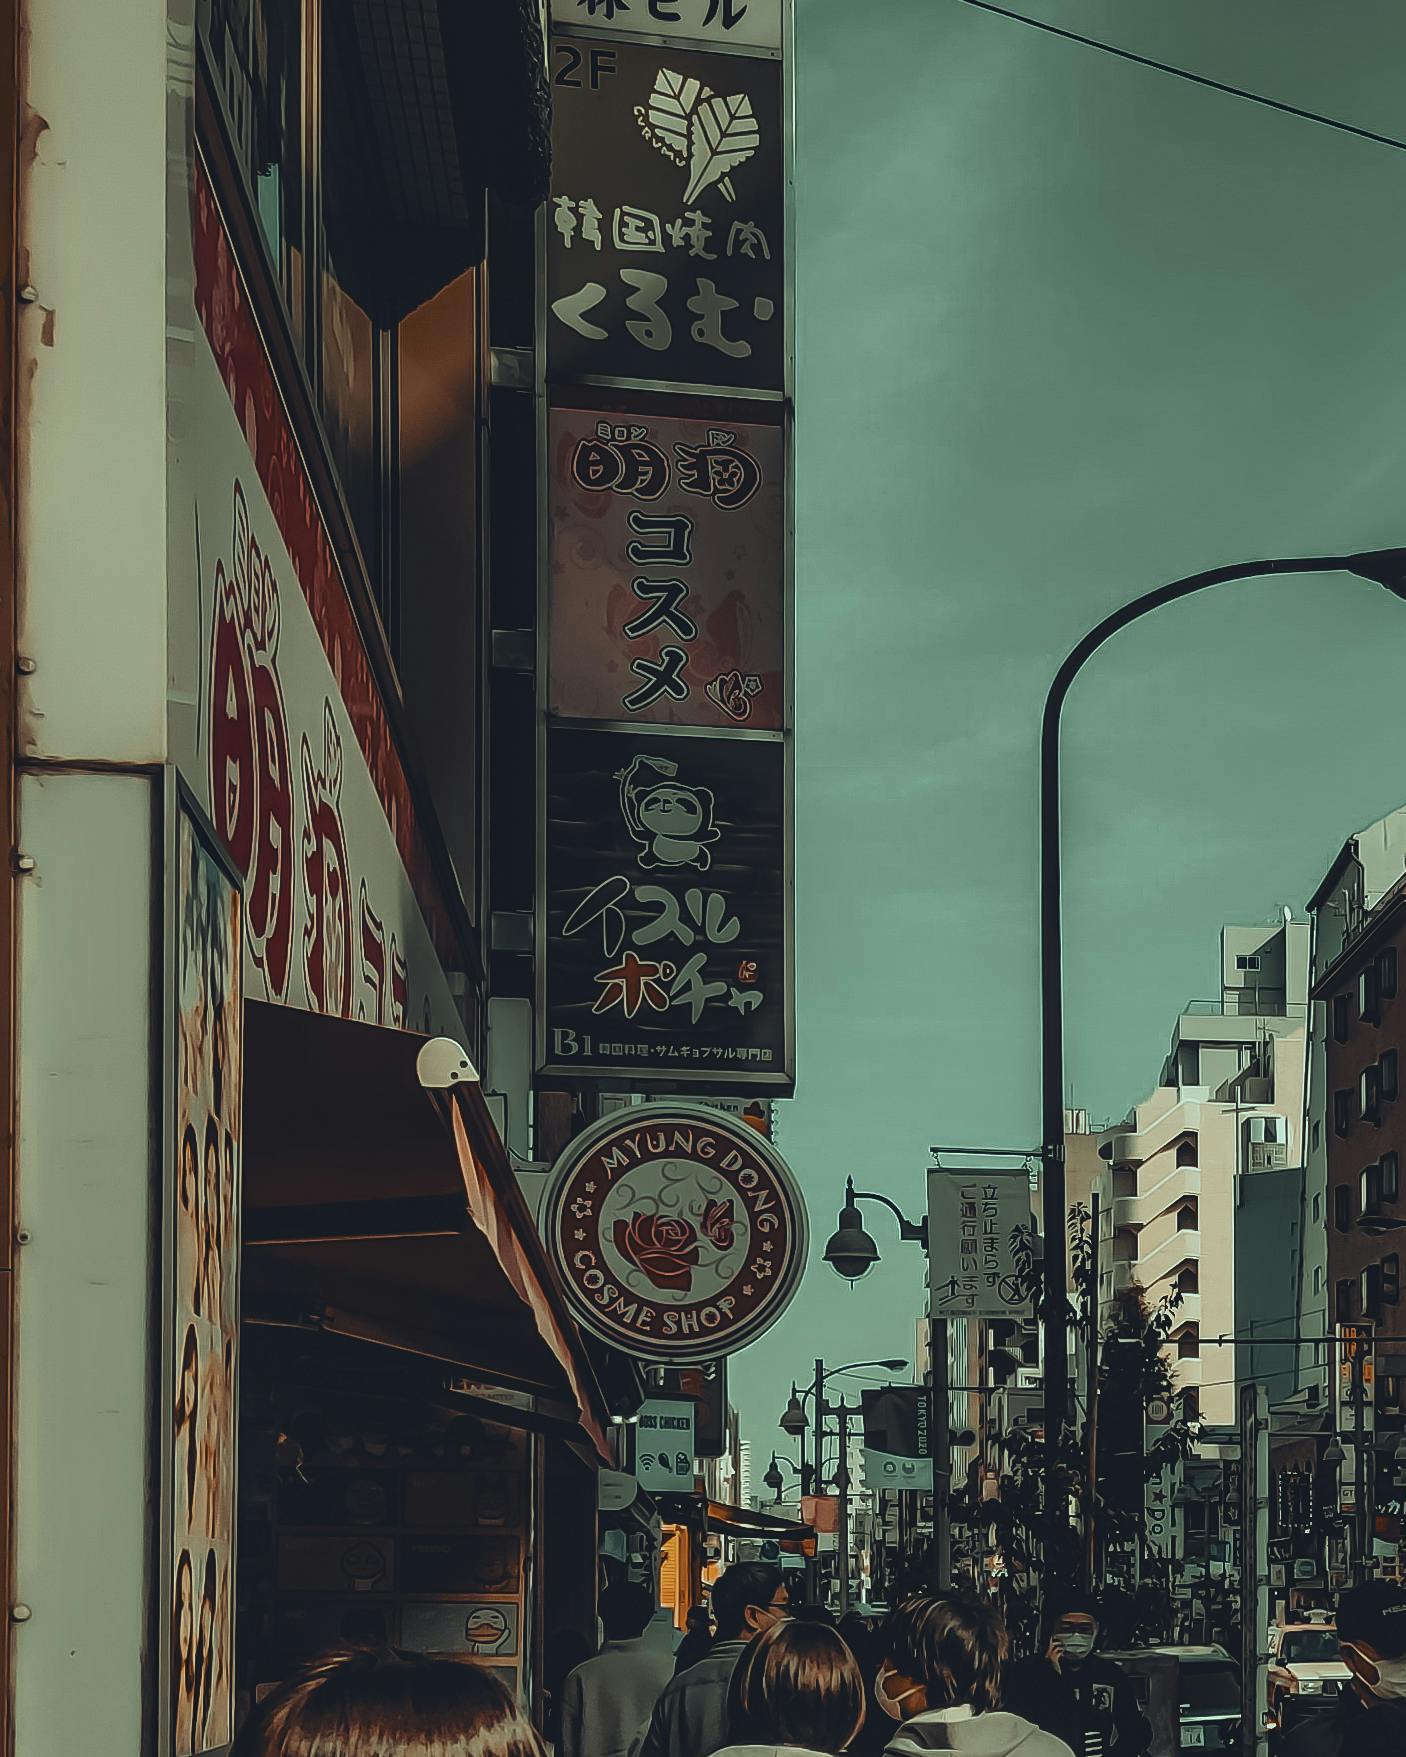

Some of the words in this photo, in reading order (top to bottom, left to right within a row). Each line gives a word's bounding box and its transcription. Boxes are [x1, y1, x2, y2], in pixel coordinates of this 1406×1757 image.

[554, 46, 617, 89] 2F
[552, 196, 771, 260] 韓国焼肉
[551, 268, 775, 358] くるむ
[623, 512, 699, 713] コスメ
[562, 876, 741, 958] イスル
[592, 950, 764, 1024] ポチャ
[552, 1028, 593, 1056] B1
[601, 1128, 716, 1180] MYUNG
[719, 1150, 780, 1233] DONG
[981, 1184, 1000, 1288] 立ち止まらず
[573, 1249, 656, 1330] COSME
[662, 1295, 736, 1335] SHOP
